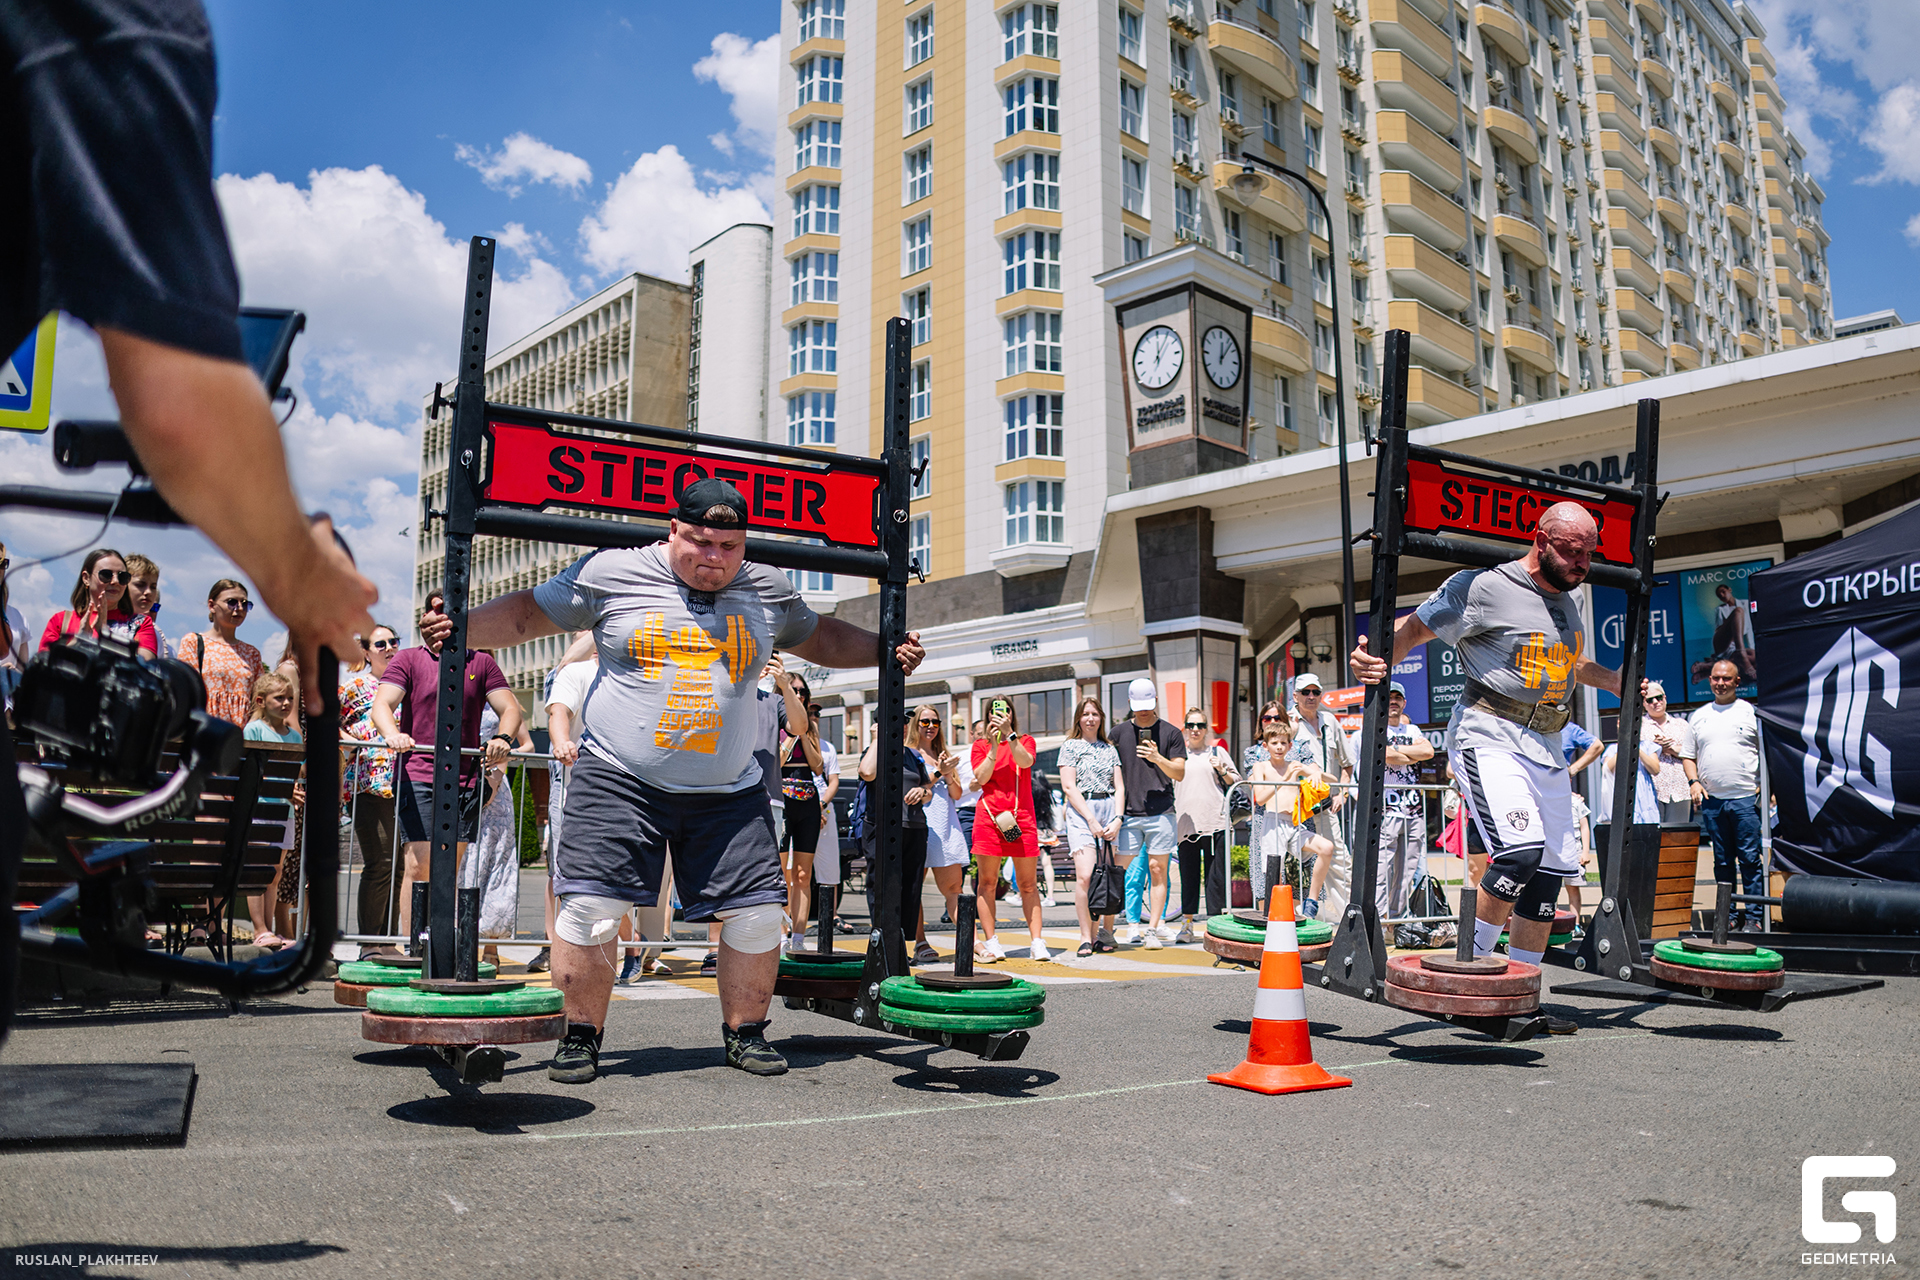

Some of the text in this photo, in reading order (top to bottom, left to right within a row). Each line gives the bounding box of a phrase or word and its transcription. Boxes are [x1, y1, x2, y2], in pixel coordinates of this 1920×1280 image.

[1440, 479, 1605, 547] STECR
[1687, 571, 1723, 585] MARC
[687, 602, 716, 614] КУБАНЬ
[1601, 609, 1674, 649] GiEL
[990, 640, 1038, 655] VERANDA
[666, 694, 720, 710] ЧЕЛОВЕК
[657, 710, 724, 731] КУБАНИ
[124, 789, 187, 832] RONIN
[1507, 810, 1529, 822] NETS
